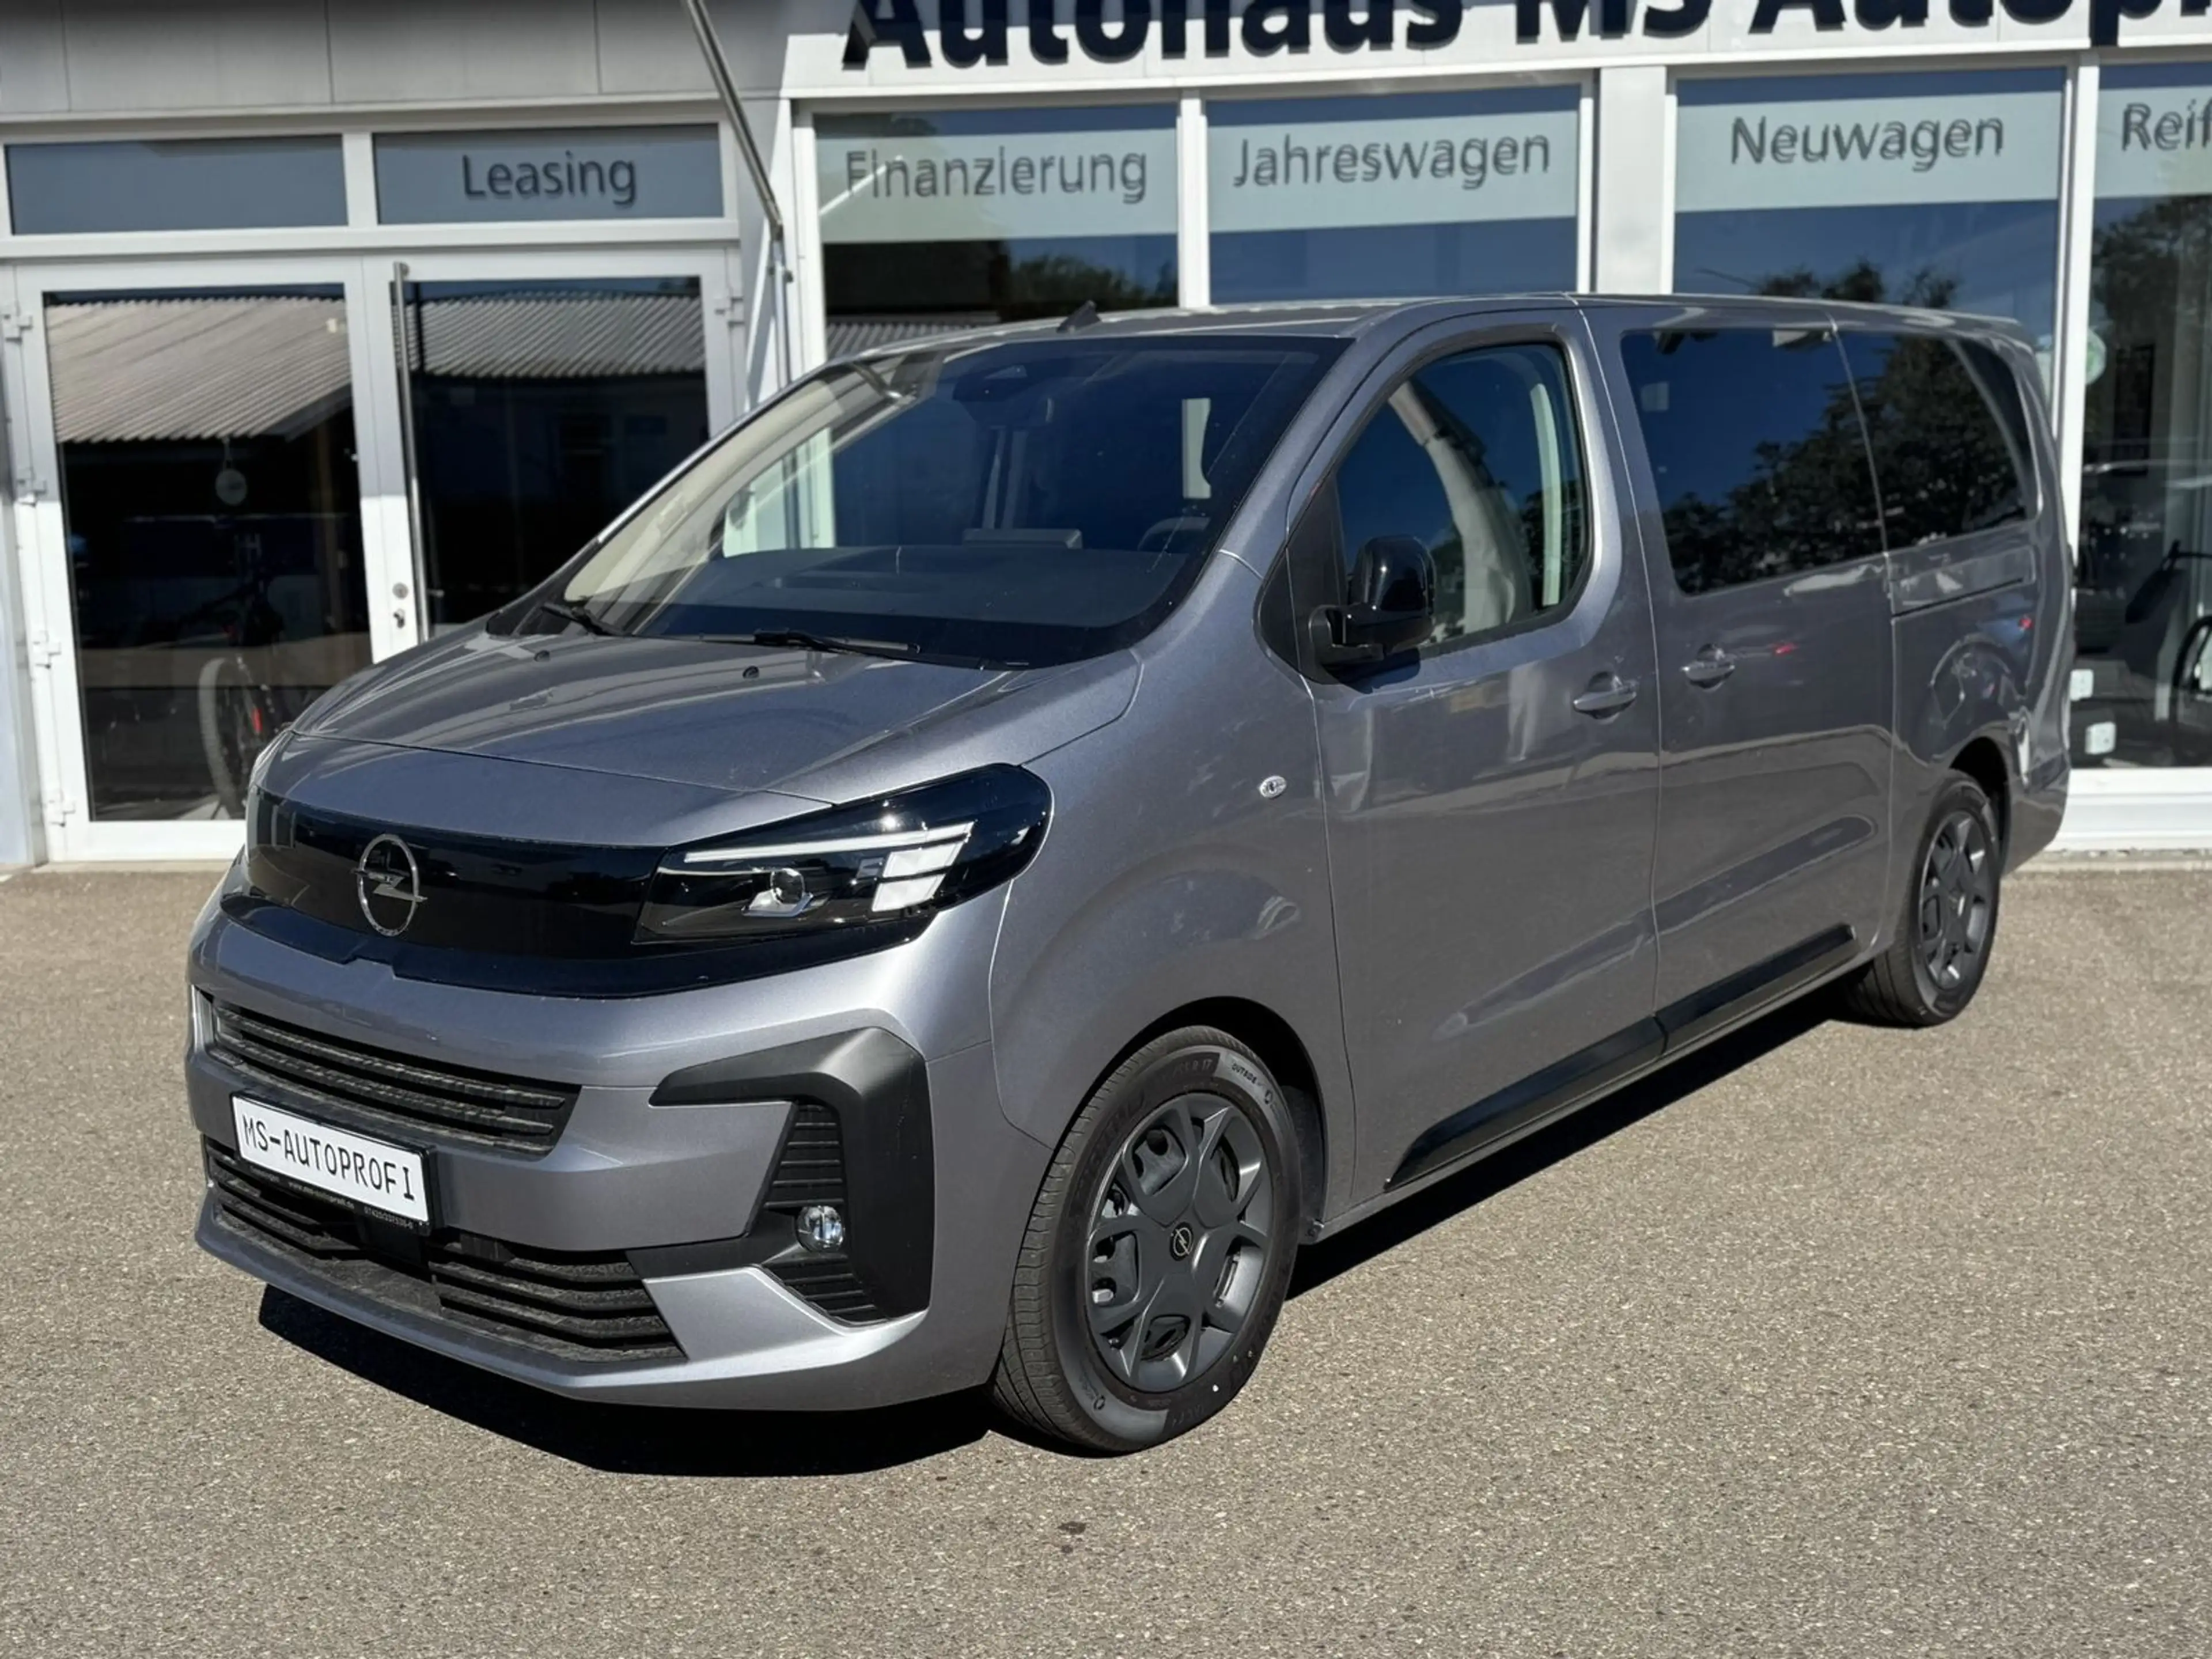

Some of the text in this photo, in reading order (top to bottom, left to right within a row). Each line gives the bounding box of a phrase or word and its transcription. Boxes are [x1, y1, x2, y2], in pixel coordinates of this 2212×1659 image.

[1233, 134, 1551, 190] Jahreswagen
[1731, 116, 2003, 172] Neuwagen
[463, 150, 637, 208] Leasing
[846, 147, 1147, 204] Finanzierung
